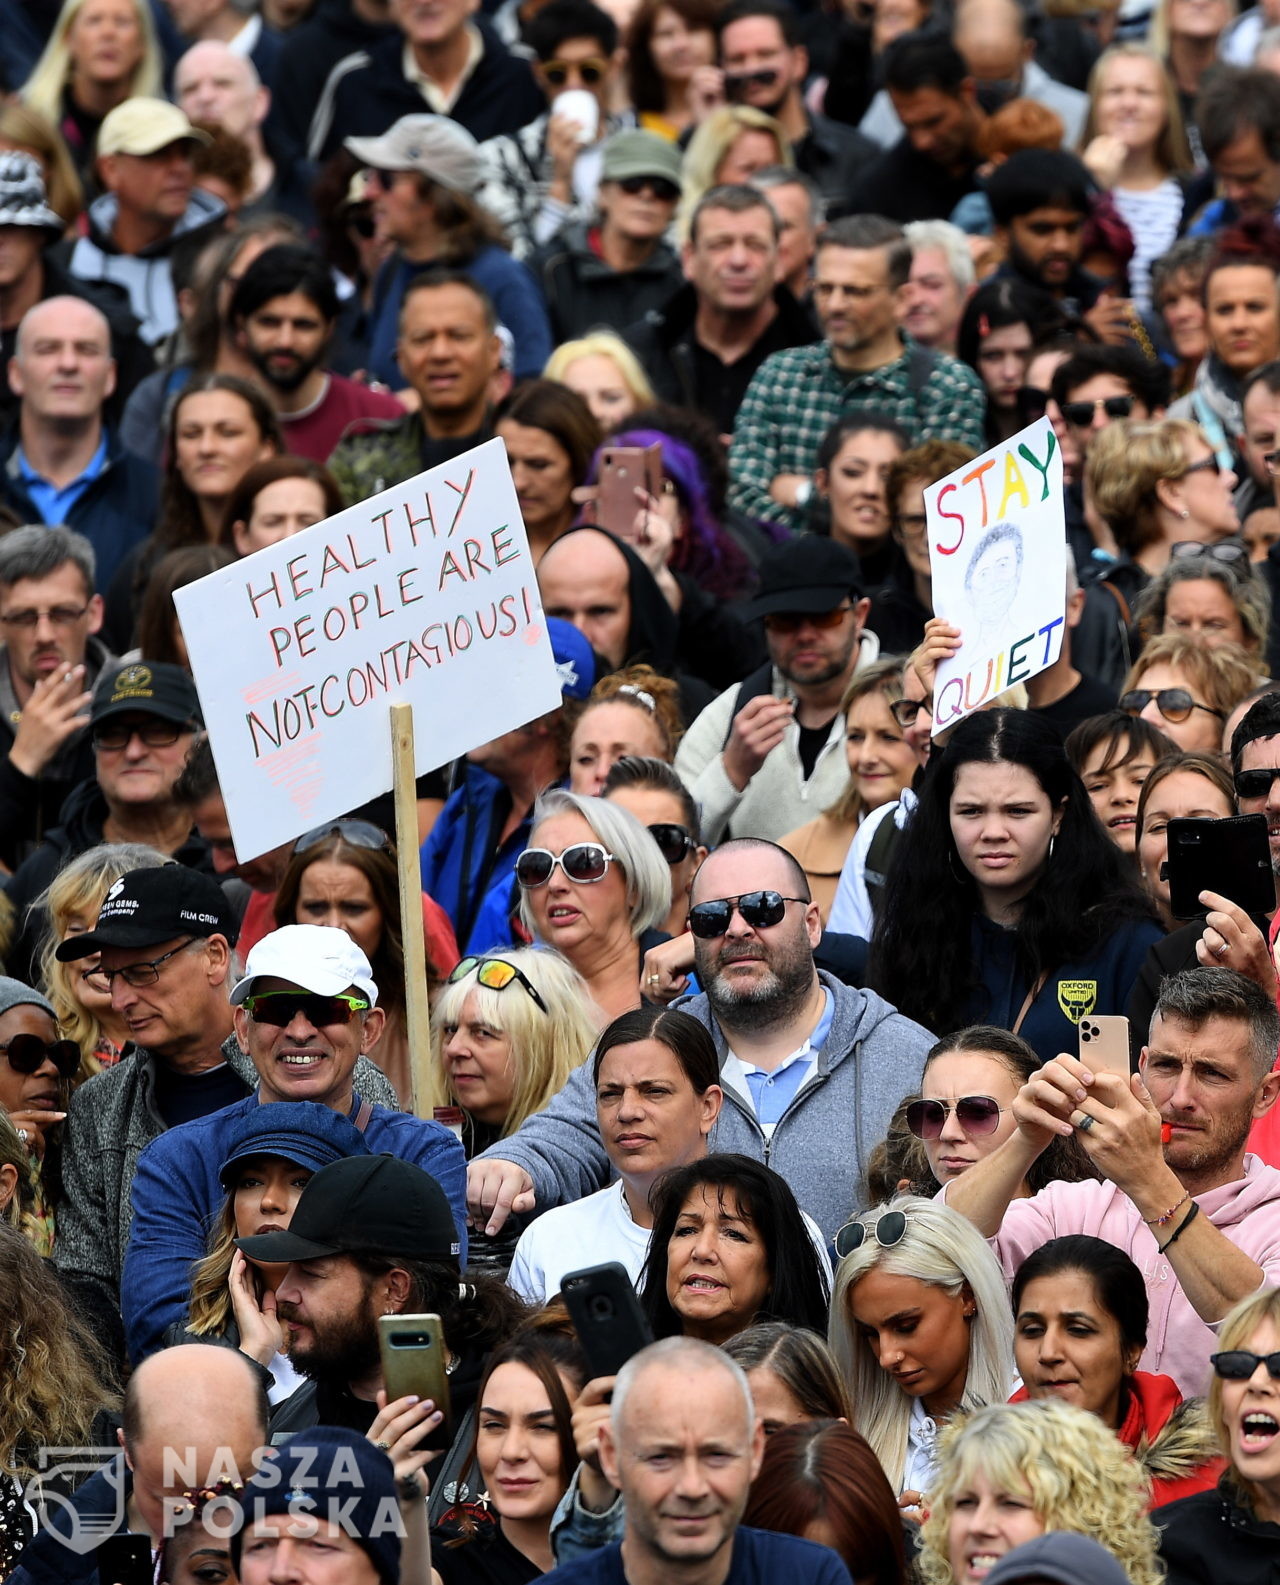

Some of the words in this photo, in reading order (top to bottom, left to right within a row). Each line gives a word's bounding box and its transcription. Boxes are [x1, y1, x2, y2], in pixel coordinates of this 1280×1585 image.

[246, 468, 478, 618] HEALTHY
[936, 431, 1056, 555] STAY
[269, 567, 424, 668] PEOPLE
[438, 524, 521, 592] ARE
[936, 616, 1064, 725] QUIET
[180, 909, 198, 921] FILM
[198, 912, 220, 925] CREW
